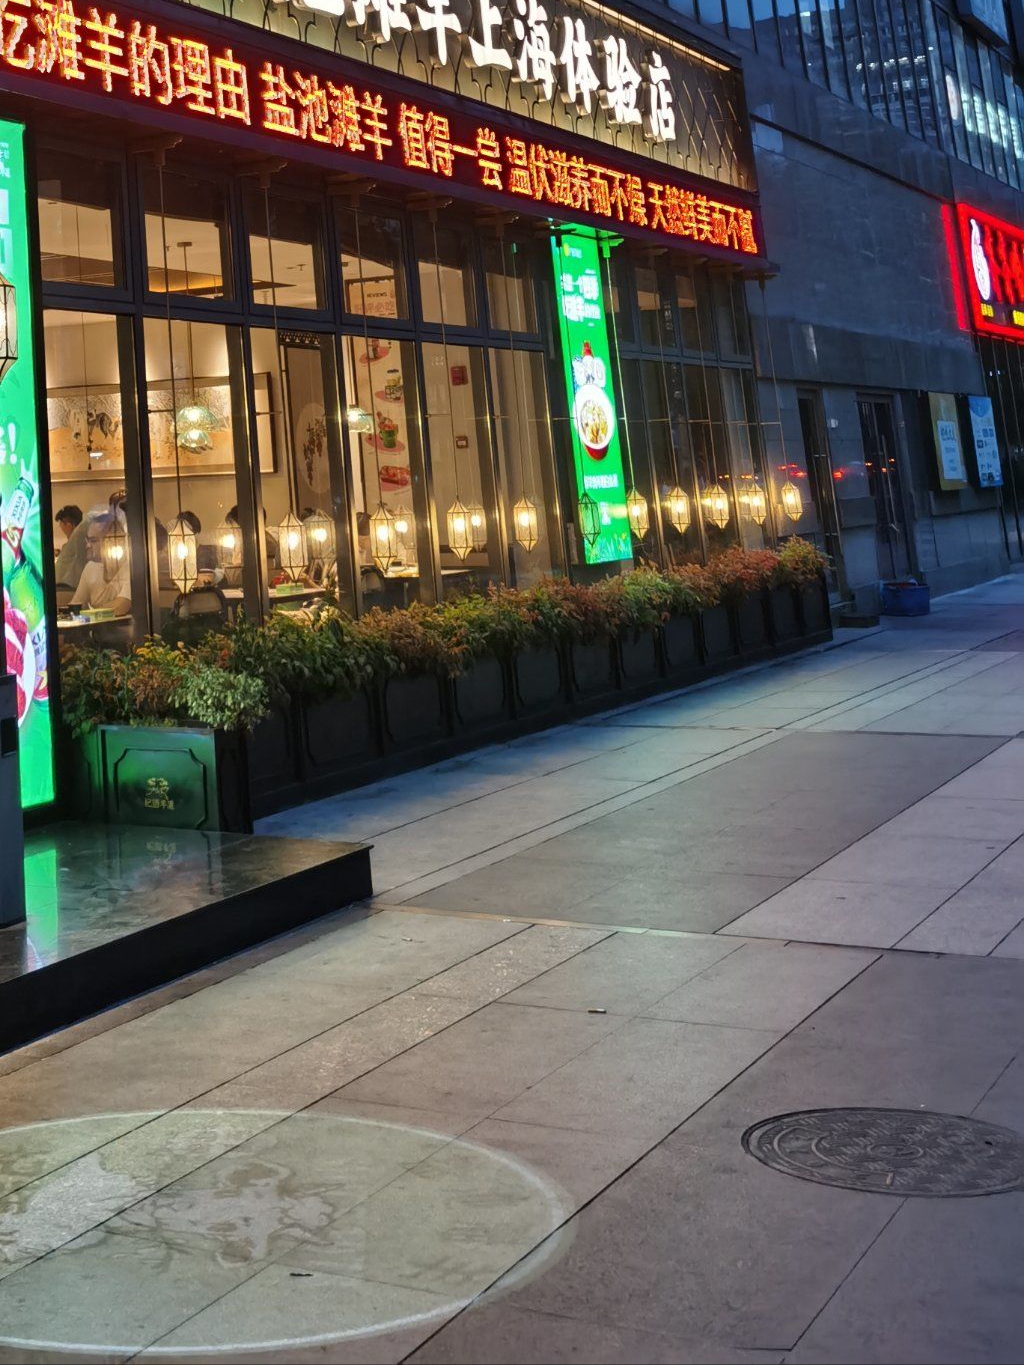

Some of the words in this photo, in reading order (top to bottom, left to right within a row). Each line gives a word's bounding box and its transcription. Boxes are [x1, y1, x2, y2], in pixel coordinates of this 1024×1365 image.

[260, 61, 394, 161] 盐池滩羊
[398, 102, 503, 191] 值得一尝
